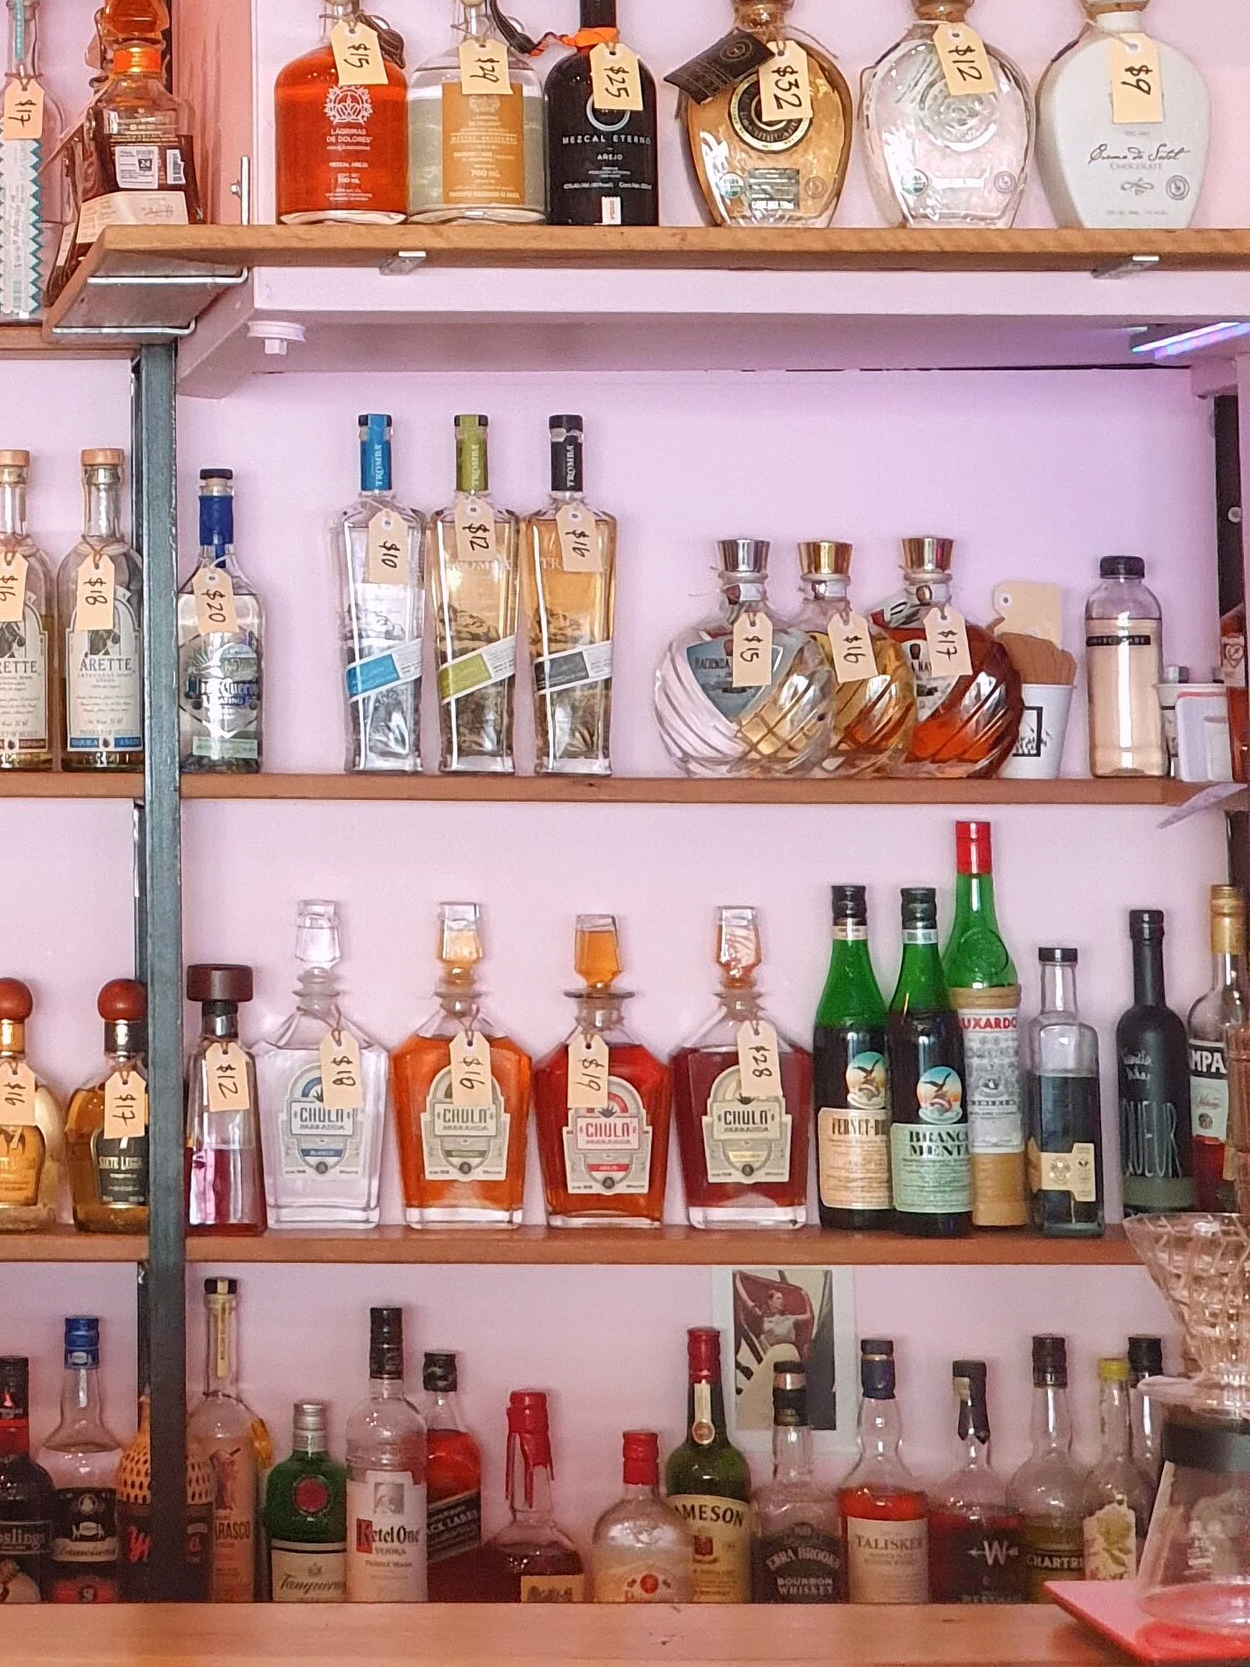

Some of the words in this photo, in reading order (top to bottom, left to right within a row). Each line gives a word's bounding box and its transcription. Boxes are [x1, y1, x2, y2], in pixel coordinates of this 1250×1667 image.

[346, 42, 373, 70] $15
[470, 57, 501, 84] $29
[947, 43, 983, 83] $12
[604, 66, 630, 99] $25
[771, 65, 802, 110] $32
[1124, 63, 1154, 97] $9
[9, 98, 37, 128] $17
[562, 135, 606, 144] MEZCAL
[613, 135, 651, 144] ETERNO
[375, 444, 383, 487] TROMBA
[471, 445, 480, 486] TROMBA
[567, 444, 575, 487] TROMBA
[464, 521, 490, 550] $12
[566, 531, 591, 559] $16
[379, 540, 399, 569] $10
[83, 576, 108, 606] $18
[202, 589, 225, 624] $20
[740, 635, 764, 664] $15
[843, 634, 864, 664] $16
[936, 630, 959, 658] $17
[79, 658, 132, 671] ARETTE
[332, 1053, 357, 1088] $18
[460, 1055, 484, 1091] $16
[577, 1056, 606, 1093] $19
[748, 1044, 773, 1079] $28
[1190, 1050, 1227, 1074] MPA
[3, 1081, 26, 1105] $16
[215, 1063, 239, 1098] $12
[112, 1093, 136, 1125] $17
[300, 1107, 344, 1123] CHULA
[443, 1108, 488, 1124] CHULA
[724, 1110, 768, 1126] CHULA
[586, 1123, 630, 1138] CHULA
[909, 1130, 970, 1143] BRANC
[674, 1503, 744, 1528] AMESON
[358, 1520, 394, 1546] Ketel
[777, 1577, 833, 1585] BOURBON
